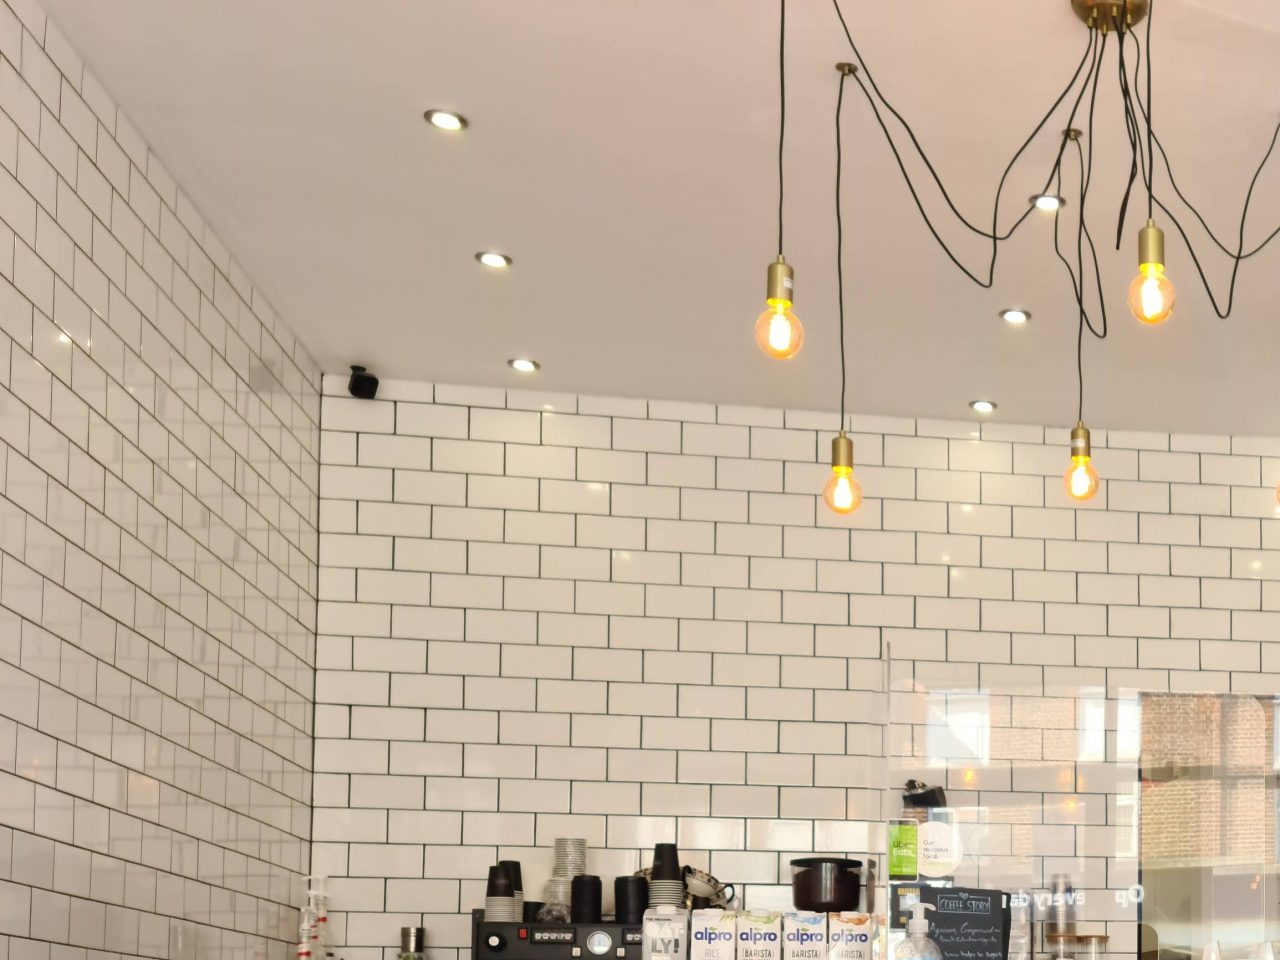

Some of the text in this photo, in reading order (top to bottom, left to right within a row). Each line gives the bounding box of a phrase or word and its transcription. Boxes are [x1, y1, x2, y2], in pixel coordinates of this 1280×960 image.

[939, 899, 989, 912] COFFEE STORY
[694, 927, 733, 944] alpro
[739, 927, 778, 945] alpro
[786, 928, 824, 945] alpro
[831, 928, 869, 946] alpro
[744, 948, 773, 958] BARISTA
[791, 949, 819, 959] BARISTA
[837, 949, 864, 960] ARISTA
